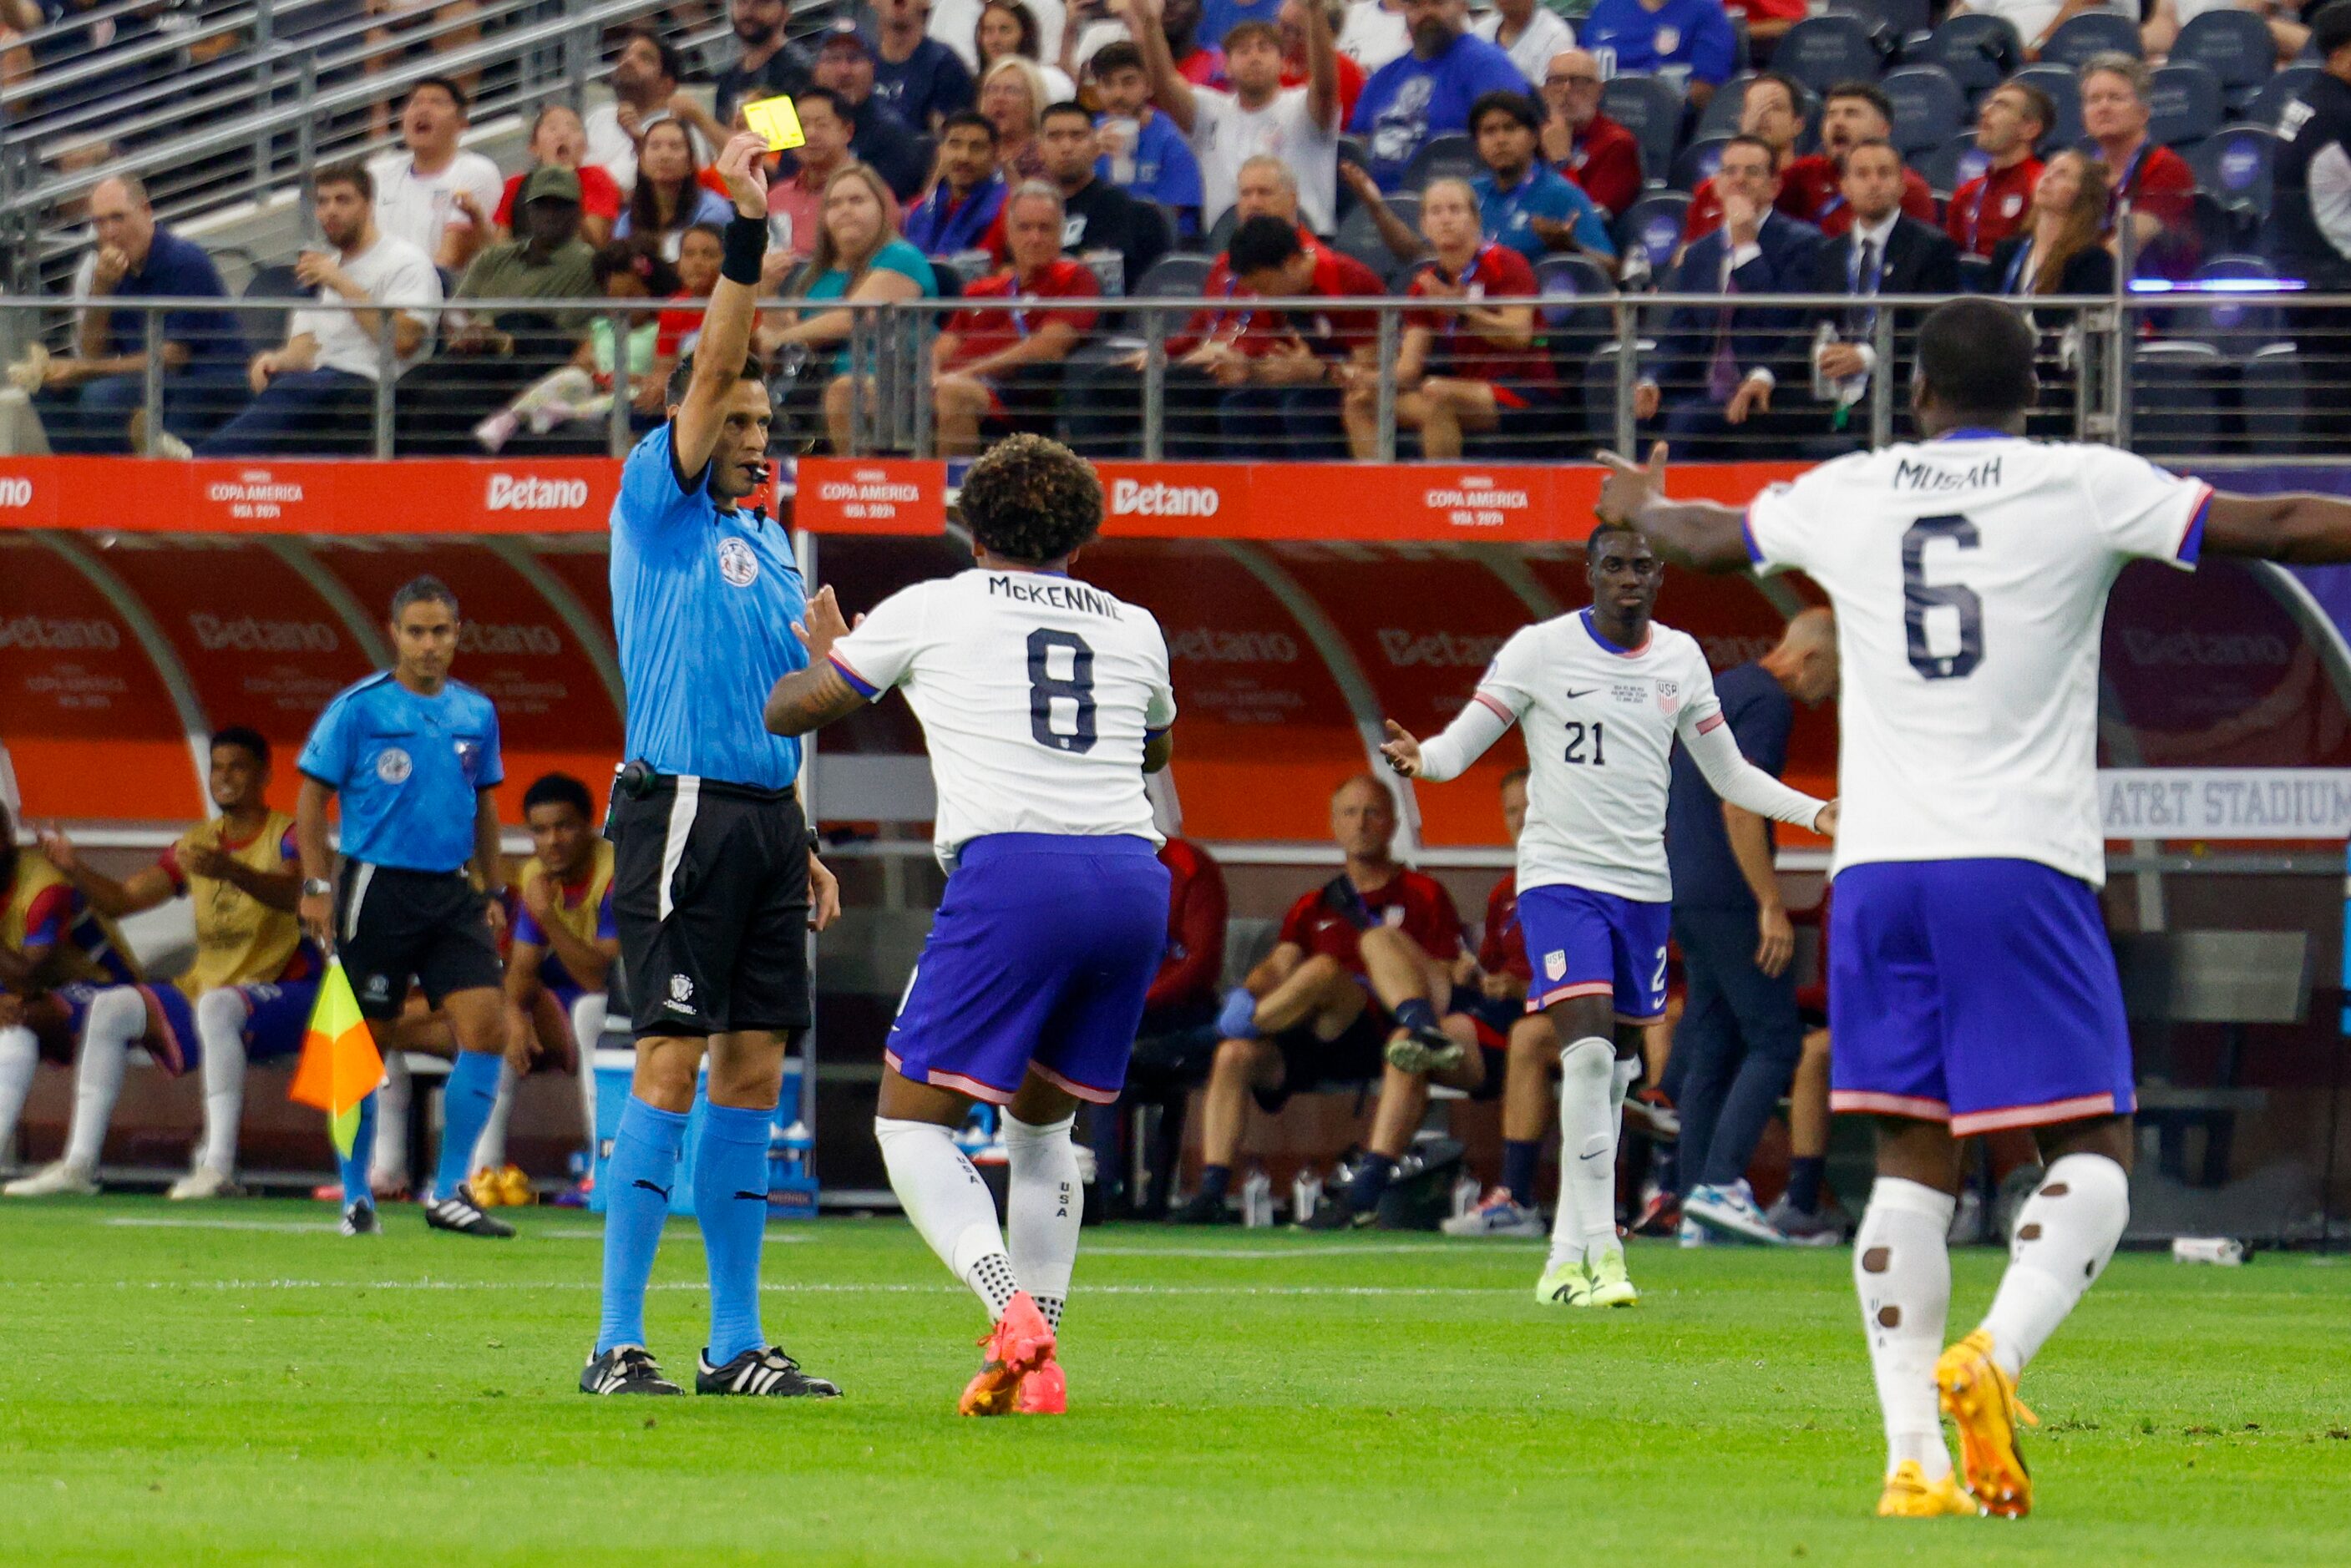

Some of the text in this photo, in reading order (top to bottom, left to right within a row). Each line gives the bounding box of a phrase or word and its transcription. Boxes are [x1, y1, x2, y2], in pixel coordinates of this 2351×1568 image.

[487, 473, 588, 511] Betano
[1893, 455, 2002, 491] MUSAH
[211, 484, 304, 502] COPA AMERICA
[822, 483, 920, 502] COPA AMERICA
[1112, 478, 1219, 517] Betano
[1426, 490, 1529, 508] COPA AMERICA
[989, 576, 1124, 623] McKENNIE
[1903, 514, 1986, 680] 6
[189, 612, 340, 654] Betano
[1027, 627, 1098, 755] 8
[1658, 682, 1677, 697] USA
[1564, 721, 1605, 766] 21
[2105, 781, 2191, 827] AT&T
[1547, 953, 1564, 965] USA
[1056, 1181, 1071, 1217] USA
